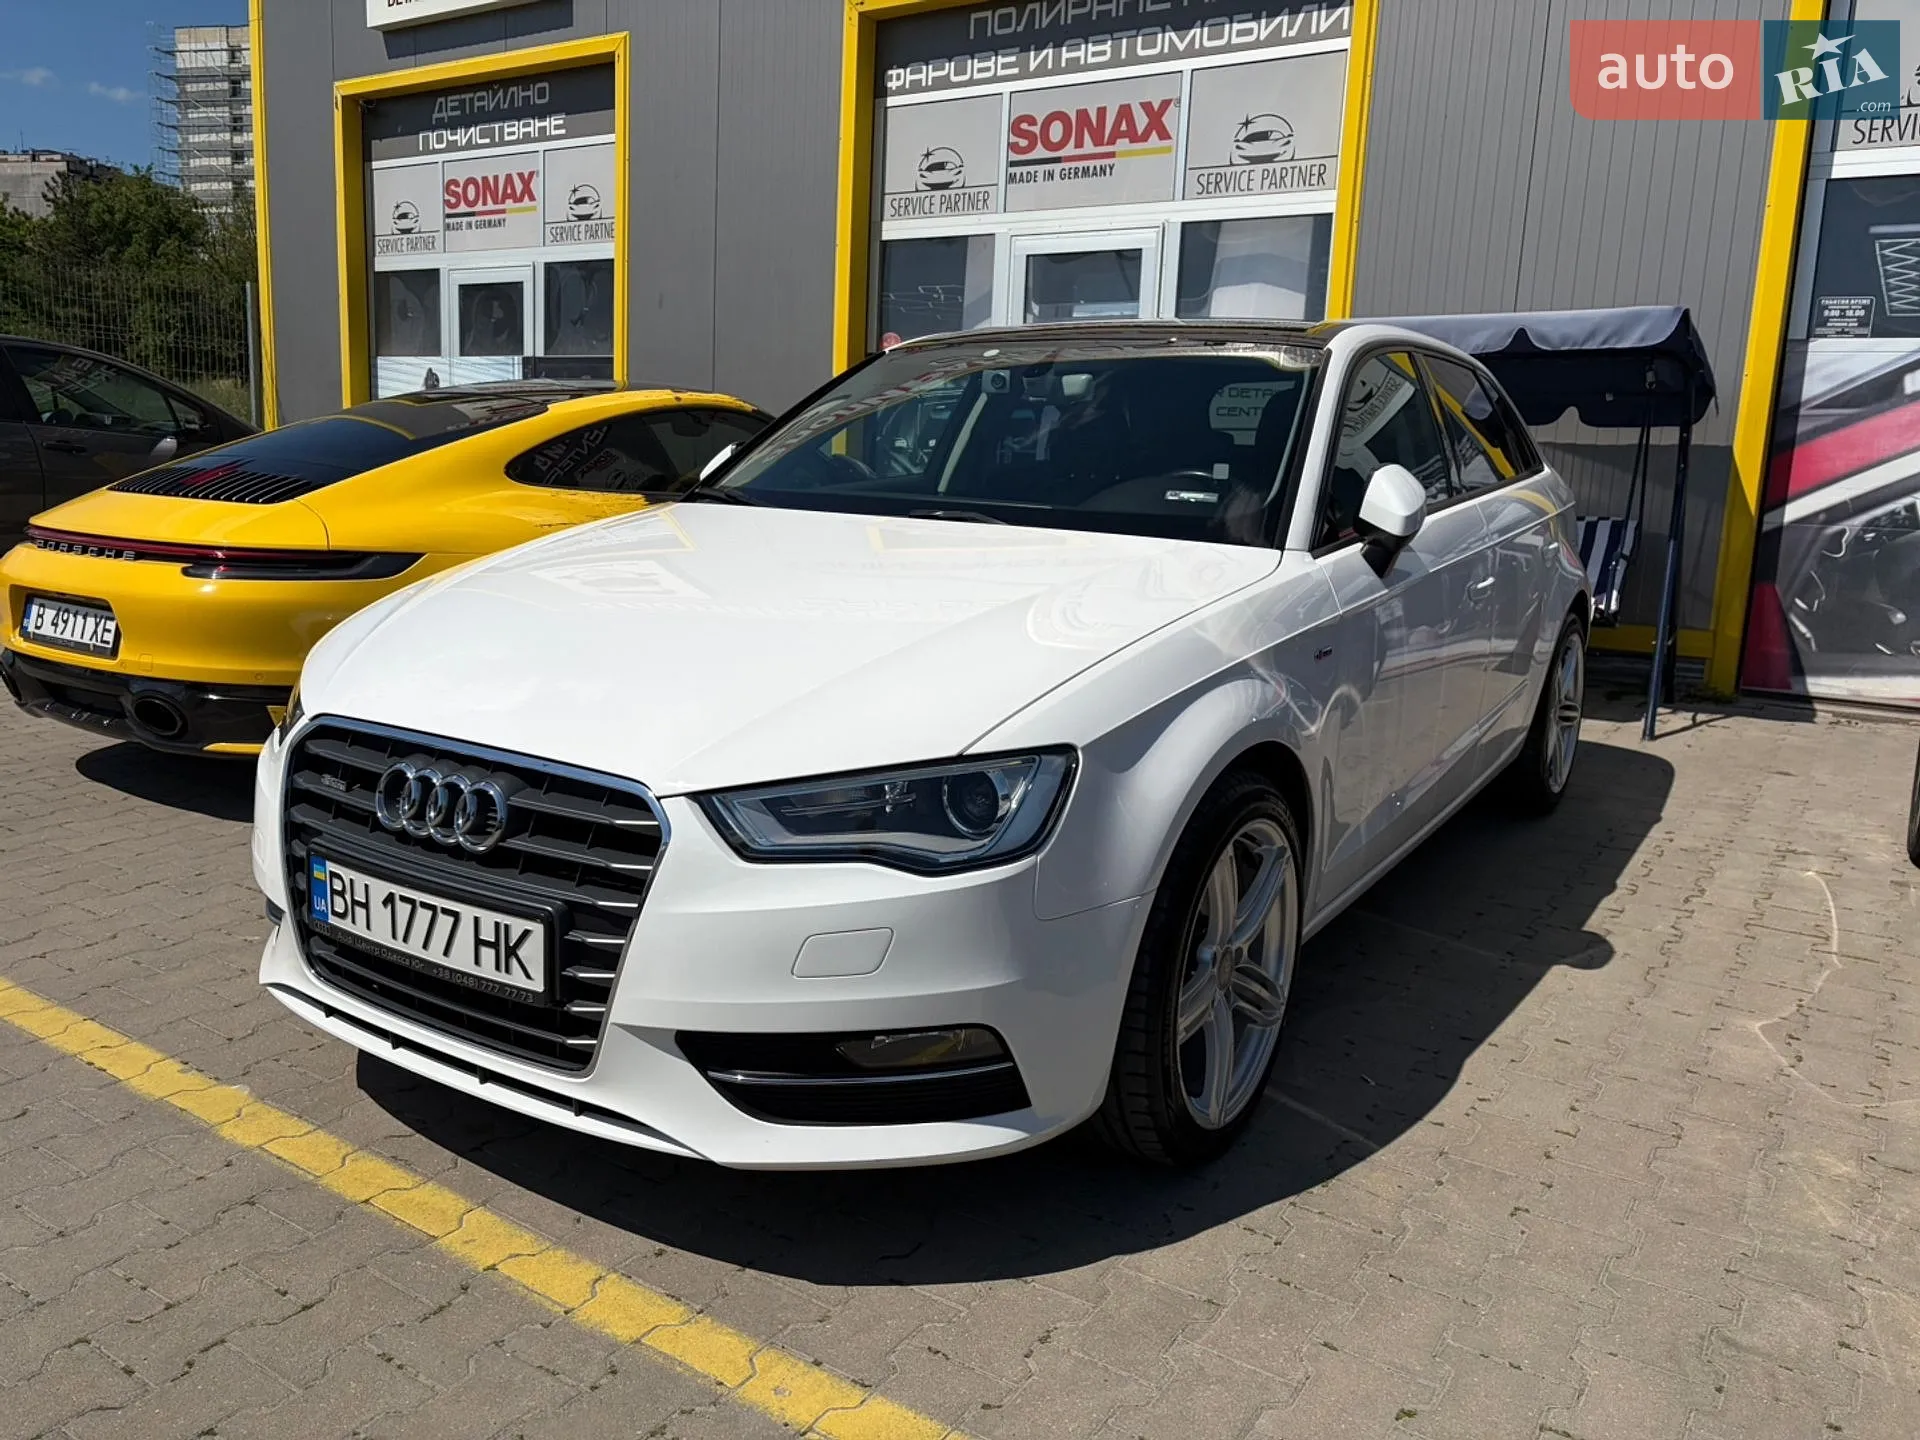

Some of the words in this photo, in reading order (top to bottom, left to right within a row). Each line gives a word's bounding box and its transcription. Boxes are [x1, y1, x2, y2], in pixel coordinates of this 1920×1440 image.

[885, 52, 1020, 92] ФАРОВЕ
[1029, 46, 1054, 72] И
[1061, 3, 1351, 68] АВТОМОБИЛИ
[432, 81, 550, 125] ДЕТАЙЛНО
[418, 113, 566, 151] ПОЧИСТВАНЕ
[1009, 98, 1175, 156] SONAX
[444, 170, 537, 210] SONAX
[1008, 172, 1039, 185] MADE
[1042, 170, 1055, 182] IN
[1058, 163, 1116, 180] GERMANY
[1196, 169, 1255, 196] SERVICE
[1260, 163, 1328, 191] PARTNER
[889, 197, 936, 217] SERVICE
[938, 190, 991, 215] PARTNER
[445, 219, 464, 231] MADE
[466, 219, 473, 230] IN
[475, 217, 507, 230] GERMANY
[549, 224, 583, 243] SERVICE
[377, 238, 405, 254] SERVICE
[406, 235, 436, 251] PARTNER
[36, 540, 136, 561] PORSCHE
[34, 603, 46, 631] B
[51, 606, 88, 639] 4911
[90, 613, 116, 645] XE
[314, 896, 327, 912] UA
[328, 868, 371, 932] BH
[381, 892, 462, 958] 1777
[473, 915, 535, 982] HK
